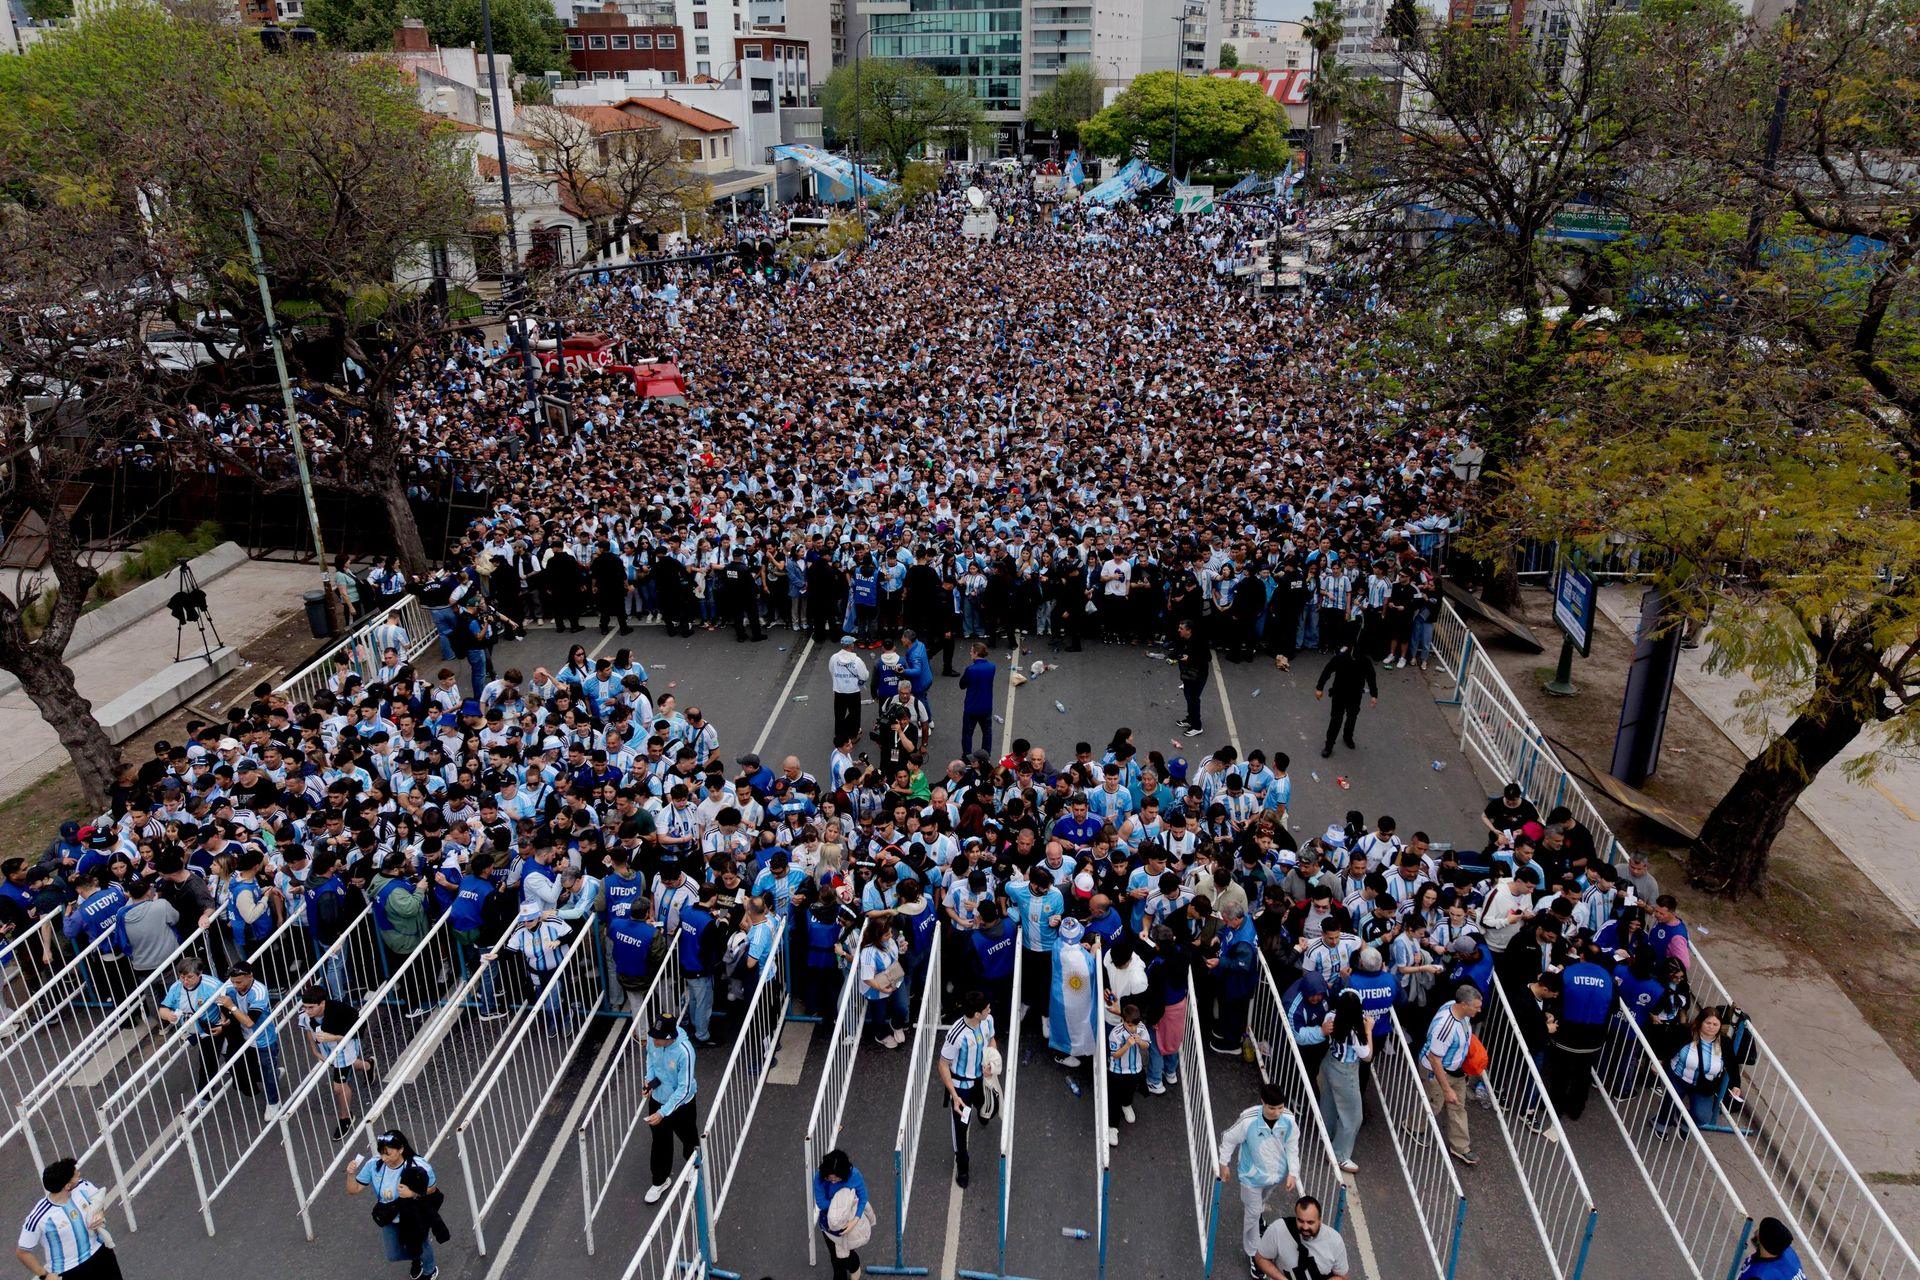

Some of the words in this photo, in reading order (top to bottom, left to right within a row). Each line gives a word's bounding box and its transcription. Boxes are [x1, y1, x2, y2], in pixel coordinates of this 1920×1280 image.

[85, 892, 119, 916] UTEDYC
[616, 931, 642, 948] UTEDYC
[987, 937, 1012, 956] UTEDYC
[1331, 964, 1341, 974] 10
[1574, 975, 1605, 988] UTEDYC
[1359, 987, 1392, 1000] UTEDYC
